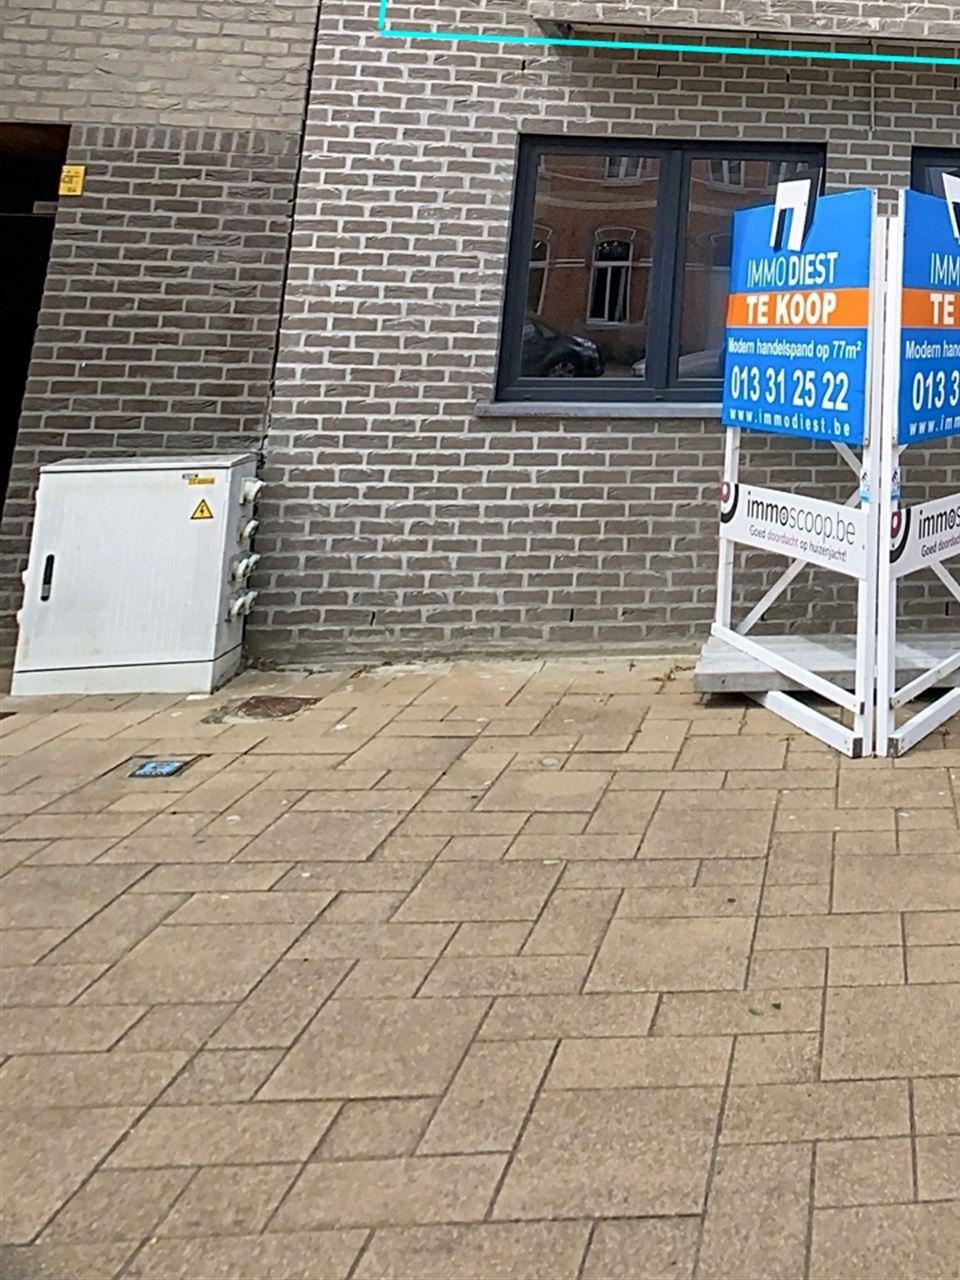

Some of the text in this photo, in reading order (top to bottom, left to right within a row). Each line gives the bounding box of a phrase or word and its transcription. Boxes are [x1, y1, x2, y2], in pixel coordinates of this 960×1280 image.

[746, 292, 837, 325] TE KOOP
[930, 293, 955, 325] TE
[728, 337, 755, 354] Modern
[756, 338, 815, 360] handelspand
[815, 344, 830, 363] op
[905, 340, 941, 360] Modern
[731, 365, 850, 412] 013 31 25 22
[912, 370, 946, 411] 013
[729, 407, 851, 437] www.immodiest.be
[747, 490, 856, 545] immoscoop.be
[749, 524, 766, 539] Goed
[921, 541, 937, 558] Goed
